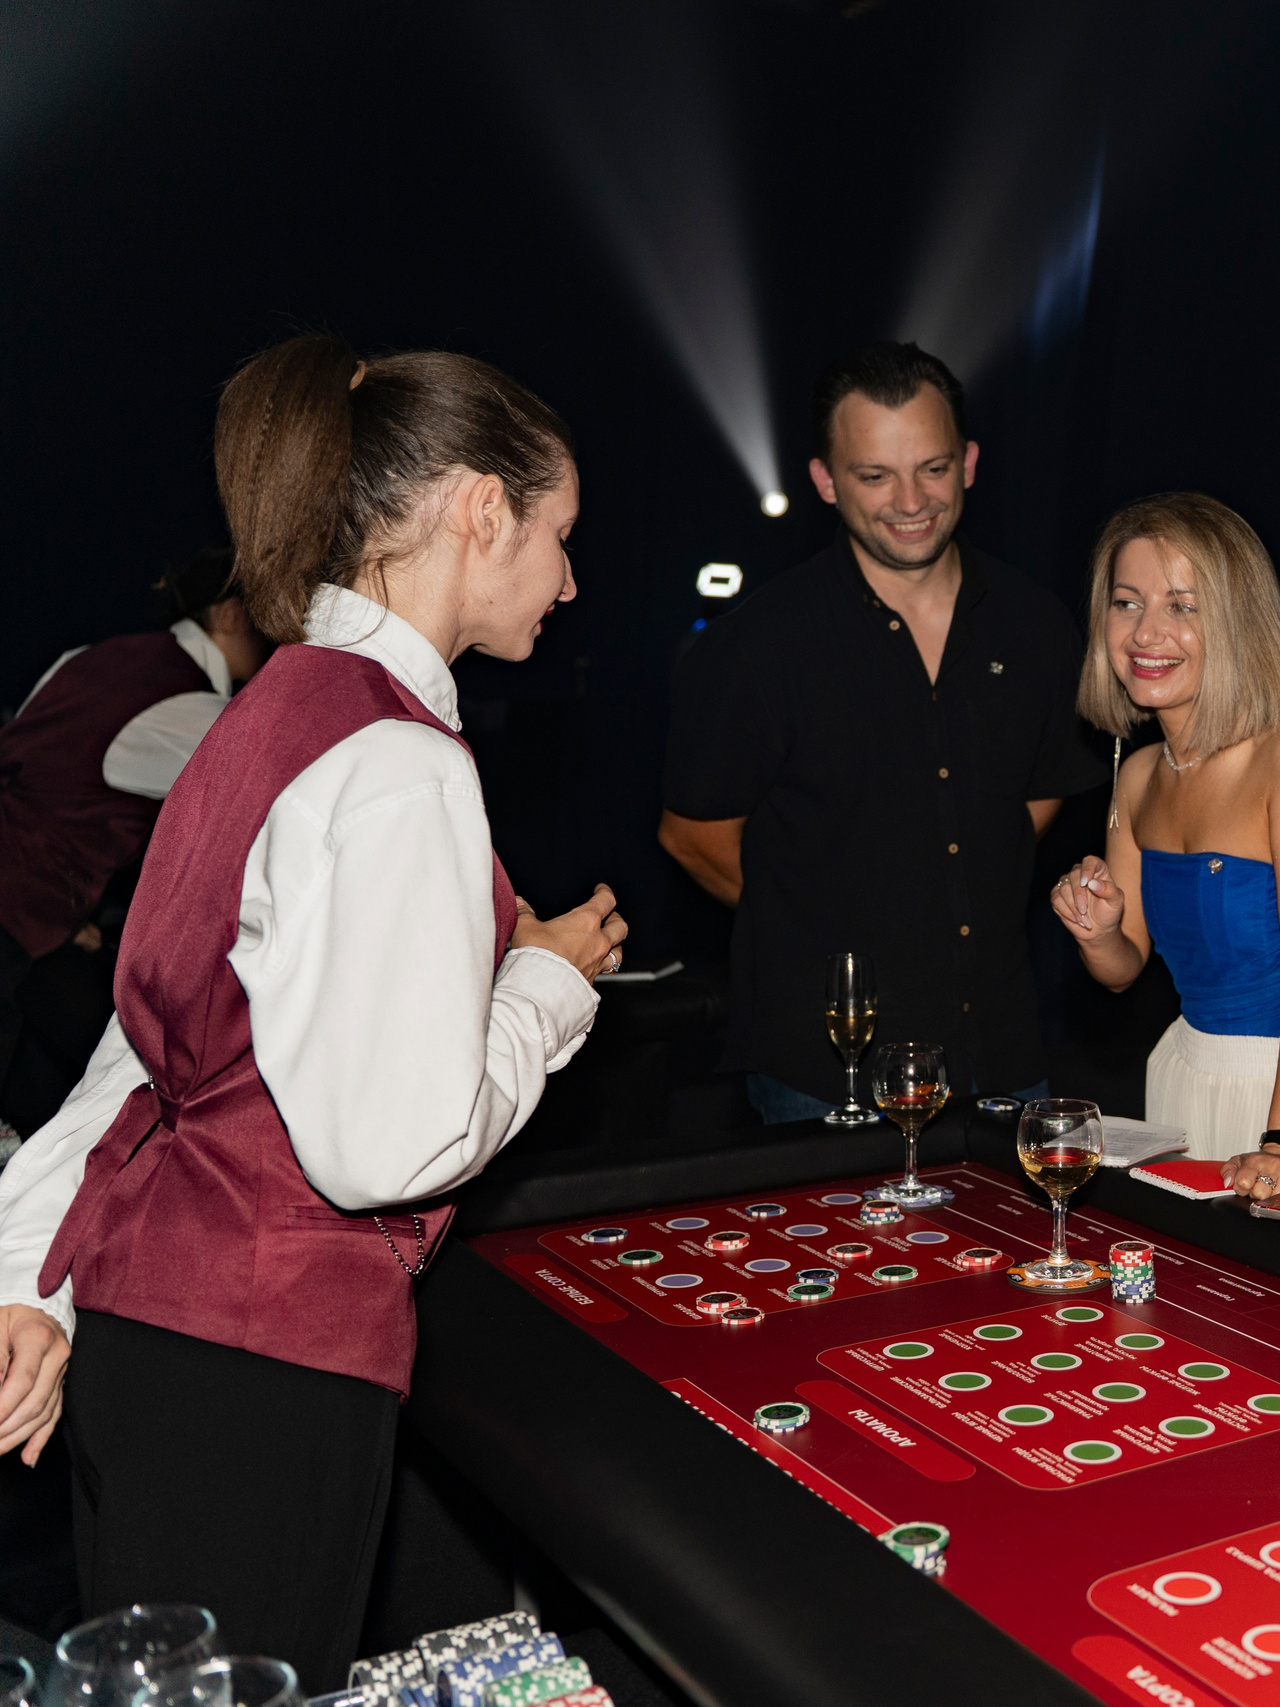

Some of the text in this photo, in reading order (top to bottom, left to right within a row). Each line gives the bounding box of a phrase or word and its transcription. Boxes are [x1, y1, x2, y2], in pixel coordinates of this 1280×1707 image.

[535, 1269, 594, 1305] БЕЛЫЕ СОРТА
[1196, 1285, 1235, 1301] Германия
[1041, 1315, 1068, 1326] ДРУГОЕ
[845, 1349, 885, 1371] ЦИТРУСОВЫЕ
[1074, 1343, 1113, 1362] ЖИВОТНЫЕ
[991, 1361, 1035, 1383] БЕНЗОЛЬНЫЕ
[1139, 1366, 1200, 1395] ЖЕЛТЫЕ ФРУКТЫ
[890, 1376, 947, 1408] БАЛЬЗАМИЧЕСКИЕ
[1043, 1392, 1093, 1419] ТРАВЯНИСТЫЕ
[848, 1409, 916, 1447] АРОМАТЫ
[951, 1412, 1003, 1442] ЧЕРНЫЕ ЯГОДЫ
[1193, 1404, 1250, 1432] КОСТОЧКОВЫЕ
[1214, 1407, 1247, 1423] ФРУКТЫ
[1113, 1429, 1160, 1454] ЦВЕТОЧНЫЕ
[1012, 1447, 1075, 1483] КРАСНЫЕ ЯГОДЫ
